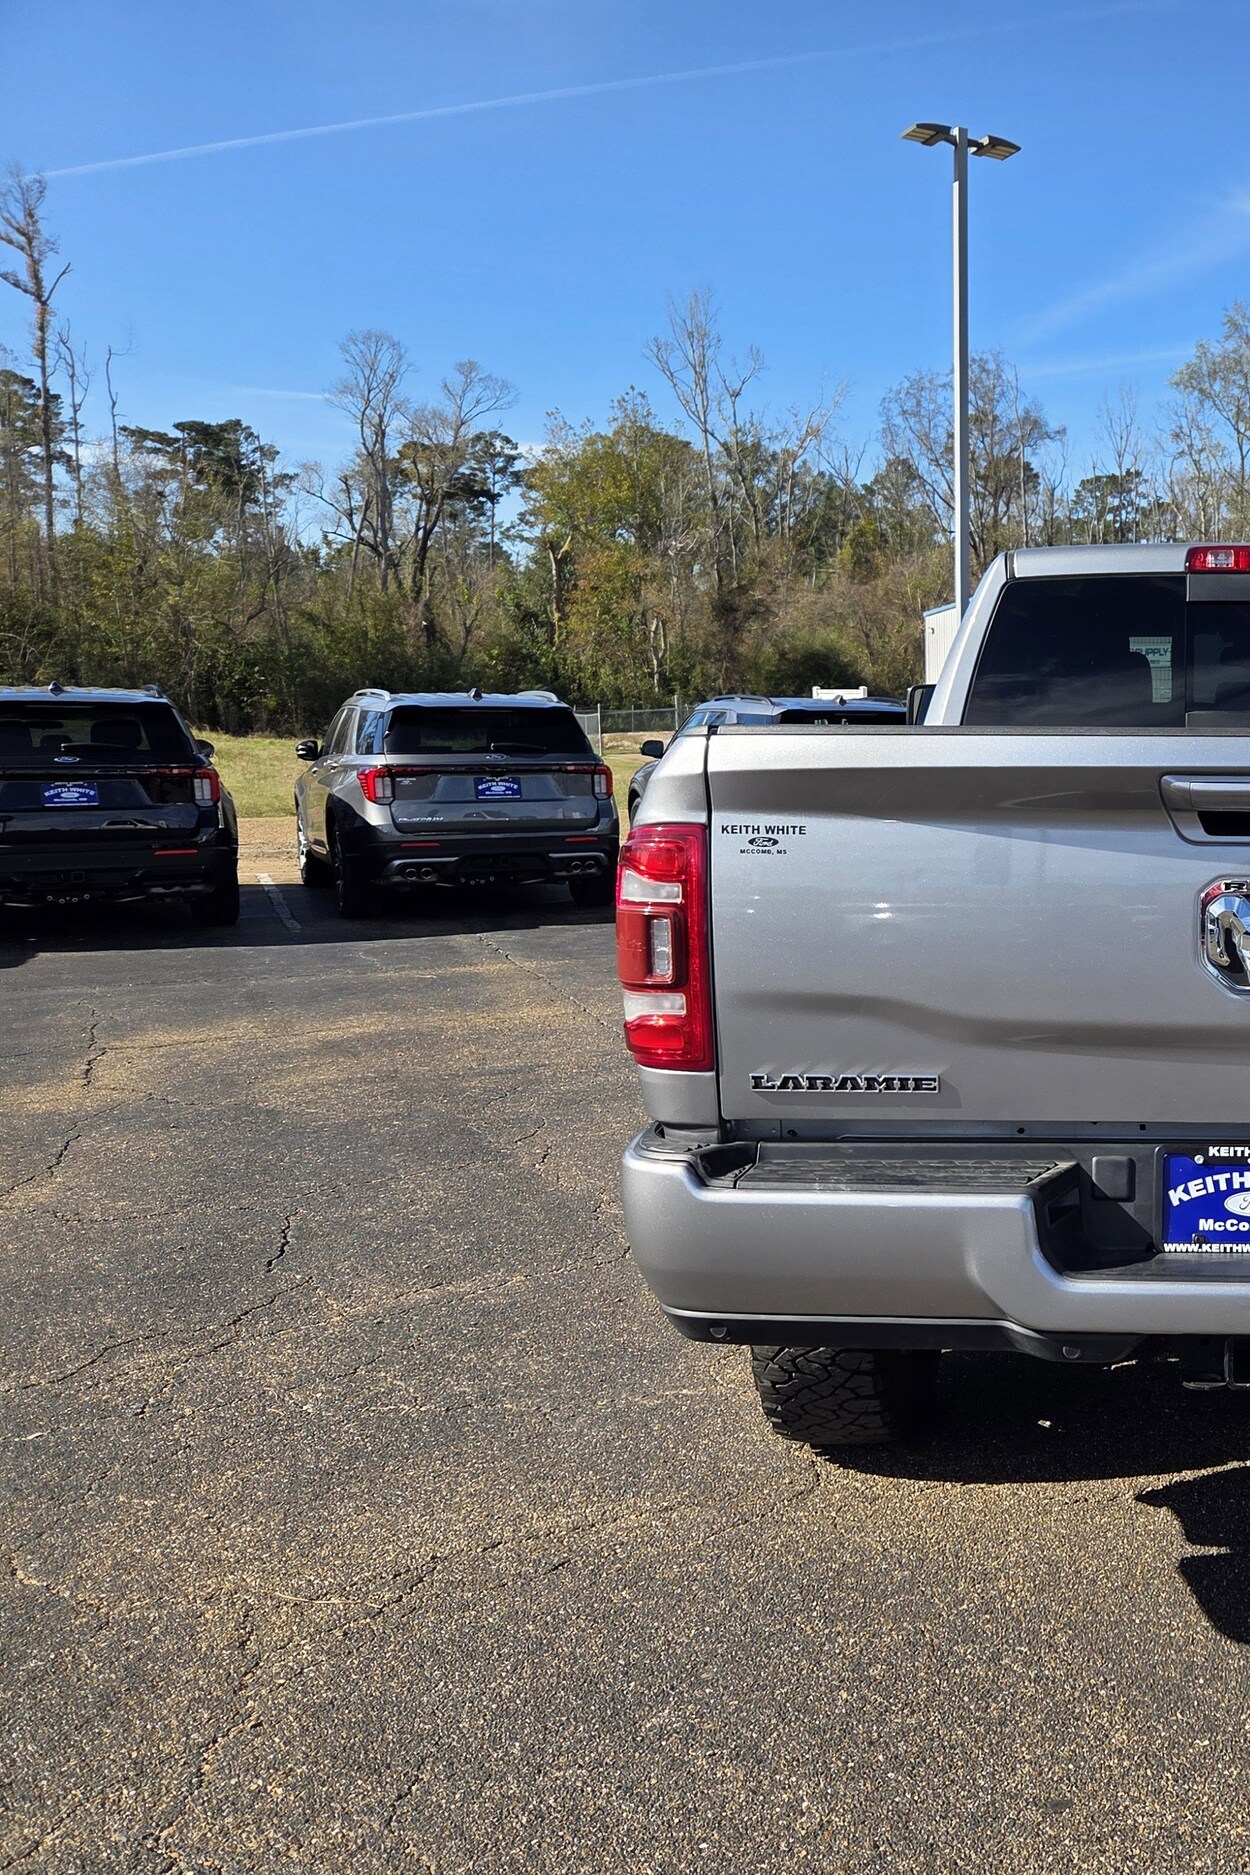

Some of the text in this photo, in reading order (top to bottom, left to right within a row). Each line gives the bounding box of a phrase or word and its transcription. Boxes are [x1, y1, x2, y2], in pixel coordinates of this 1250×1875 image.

[44, 787, 95, 797] KEITH WHITE
[721, 824, 807, 835] KEITH WHITE
[752, 837, 774, 847] Ford
[749, 1073, 940, 1093] LARAMIE
